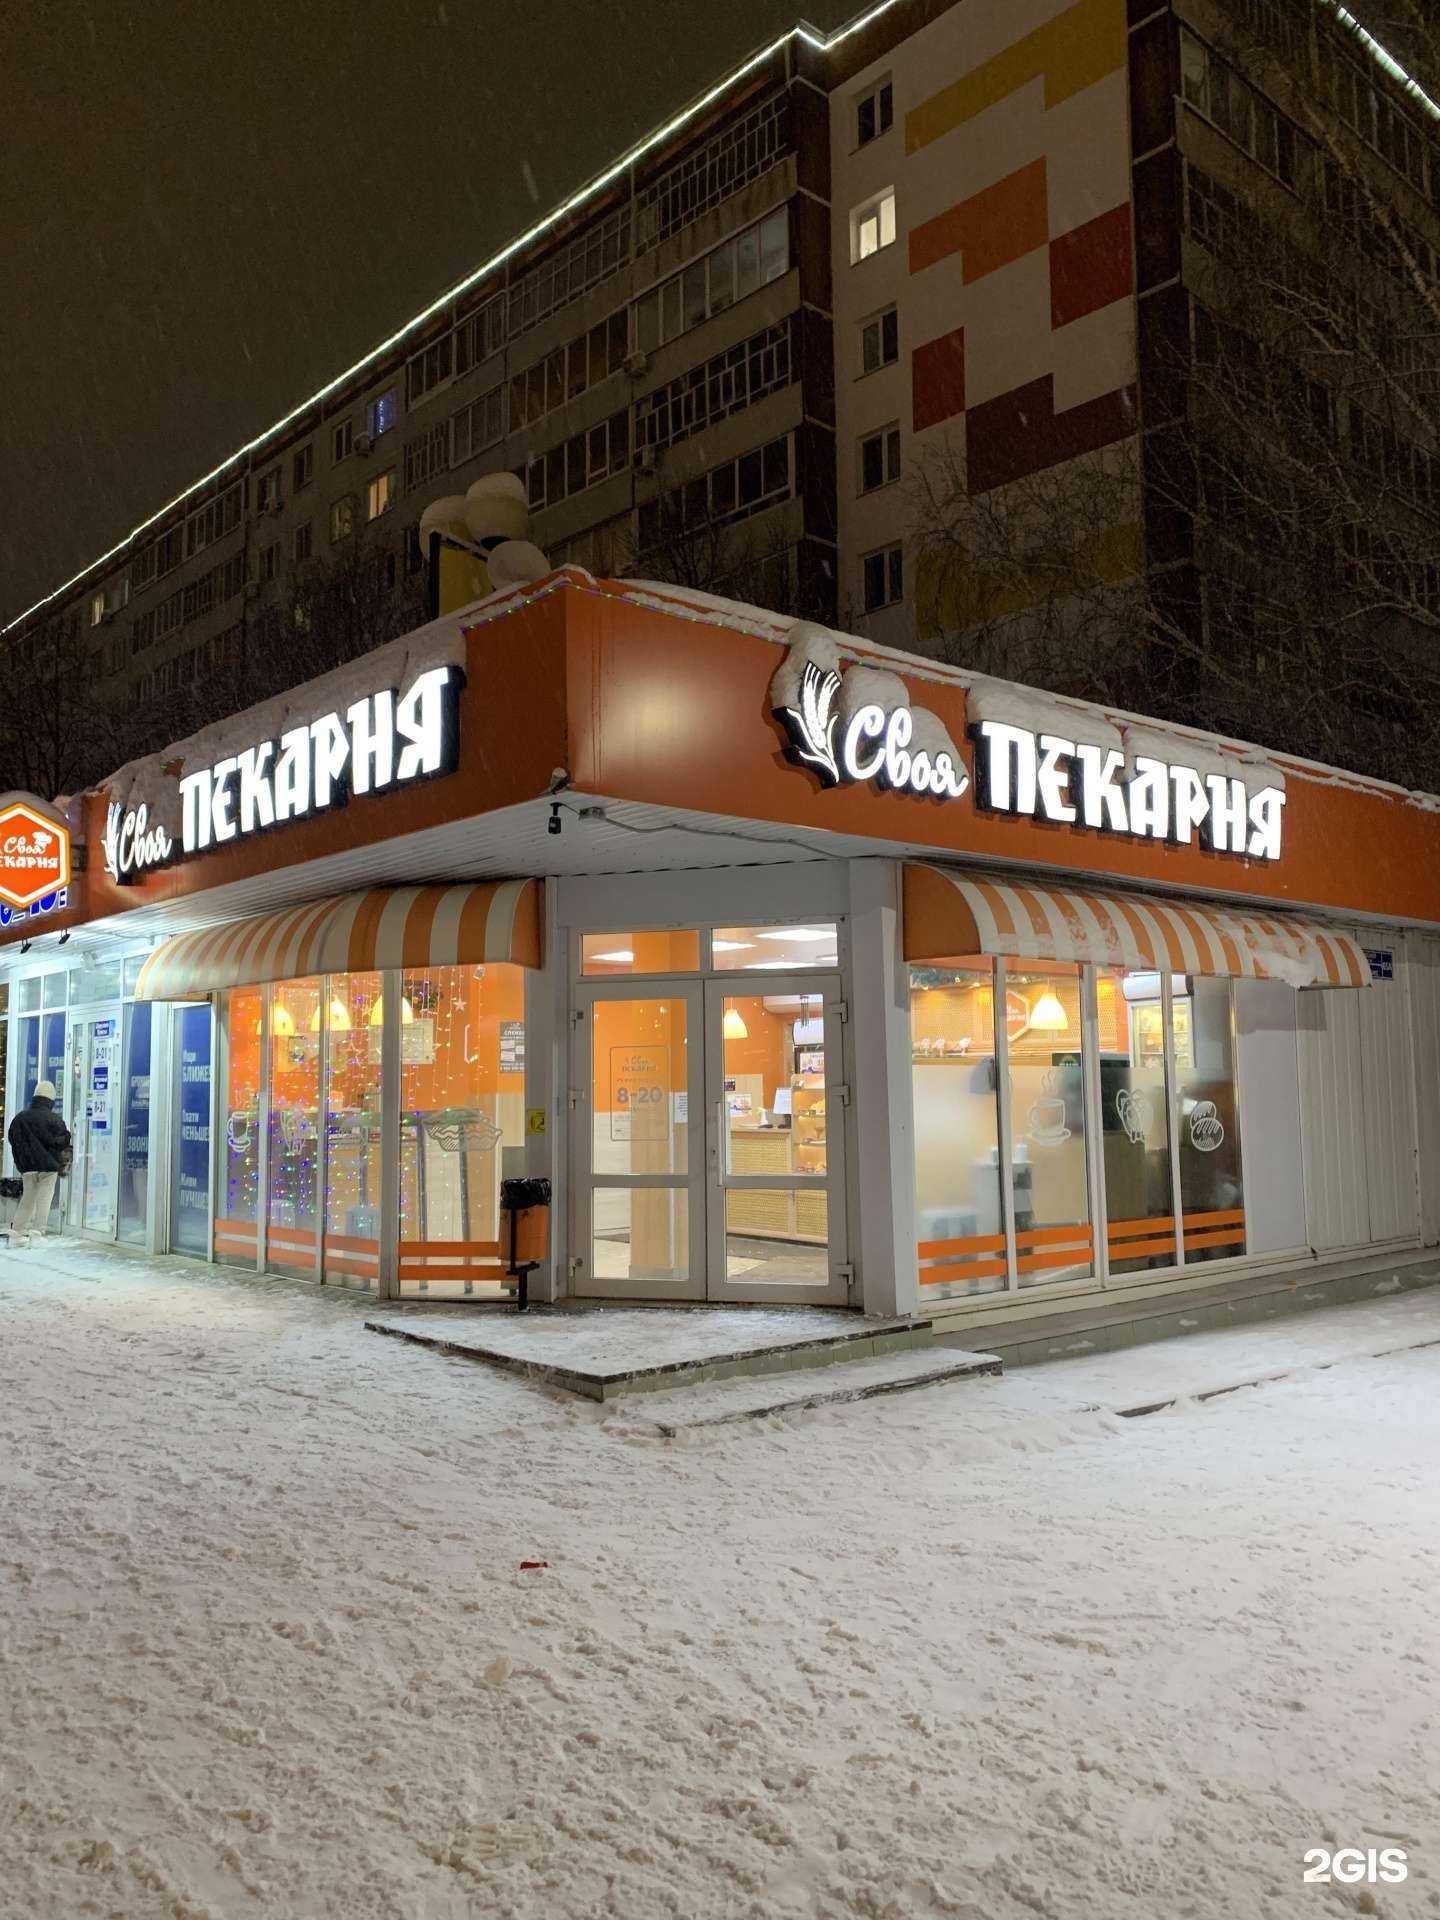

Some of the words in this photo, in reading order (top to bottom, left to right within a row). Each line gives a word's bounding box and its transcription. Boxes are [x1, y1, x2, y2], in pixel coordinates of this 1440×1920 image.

[120, 803, 172, 873] Своя
[179, 666, 449, 853] ПЕКАРНЯ
[844, 705, 969, 797] Своя
[981, 720, 1287, 860] ПЕКАРНЯ
[4, 836, 47, 855] Своя
[617, 1087, 663, 1103] 8-20
